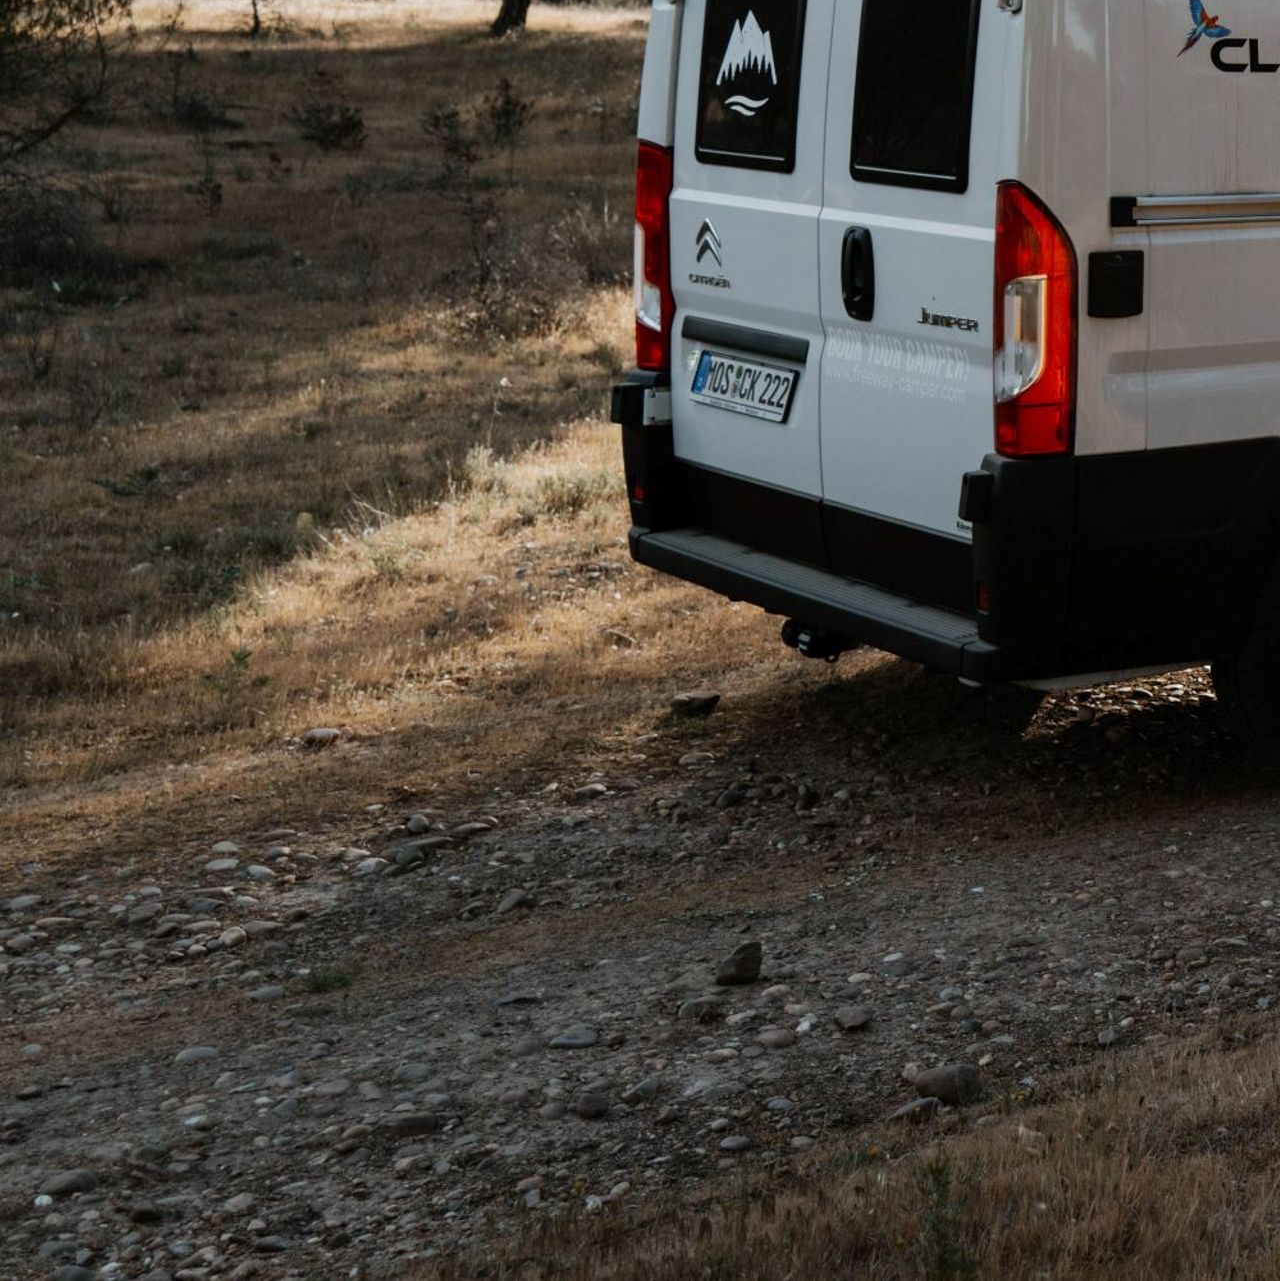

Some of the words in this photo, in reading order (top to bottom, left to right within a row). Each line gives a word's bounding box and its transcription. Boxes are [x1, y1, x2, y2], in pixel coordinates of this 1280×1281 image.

[826, 326, 863, 361] BOOK
[865, 332, 901, 369] YOUR
[905, 339, 970, 383] CAMPER!
[708, 360, 734, 395] MOS
[739, 368, 762, 402] CK
[758, 373, 790, 408] 222
